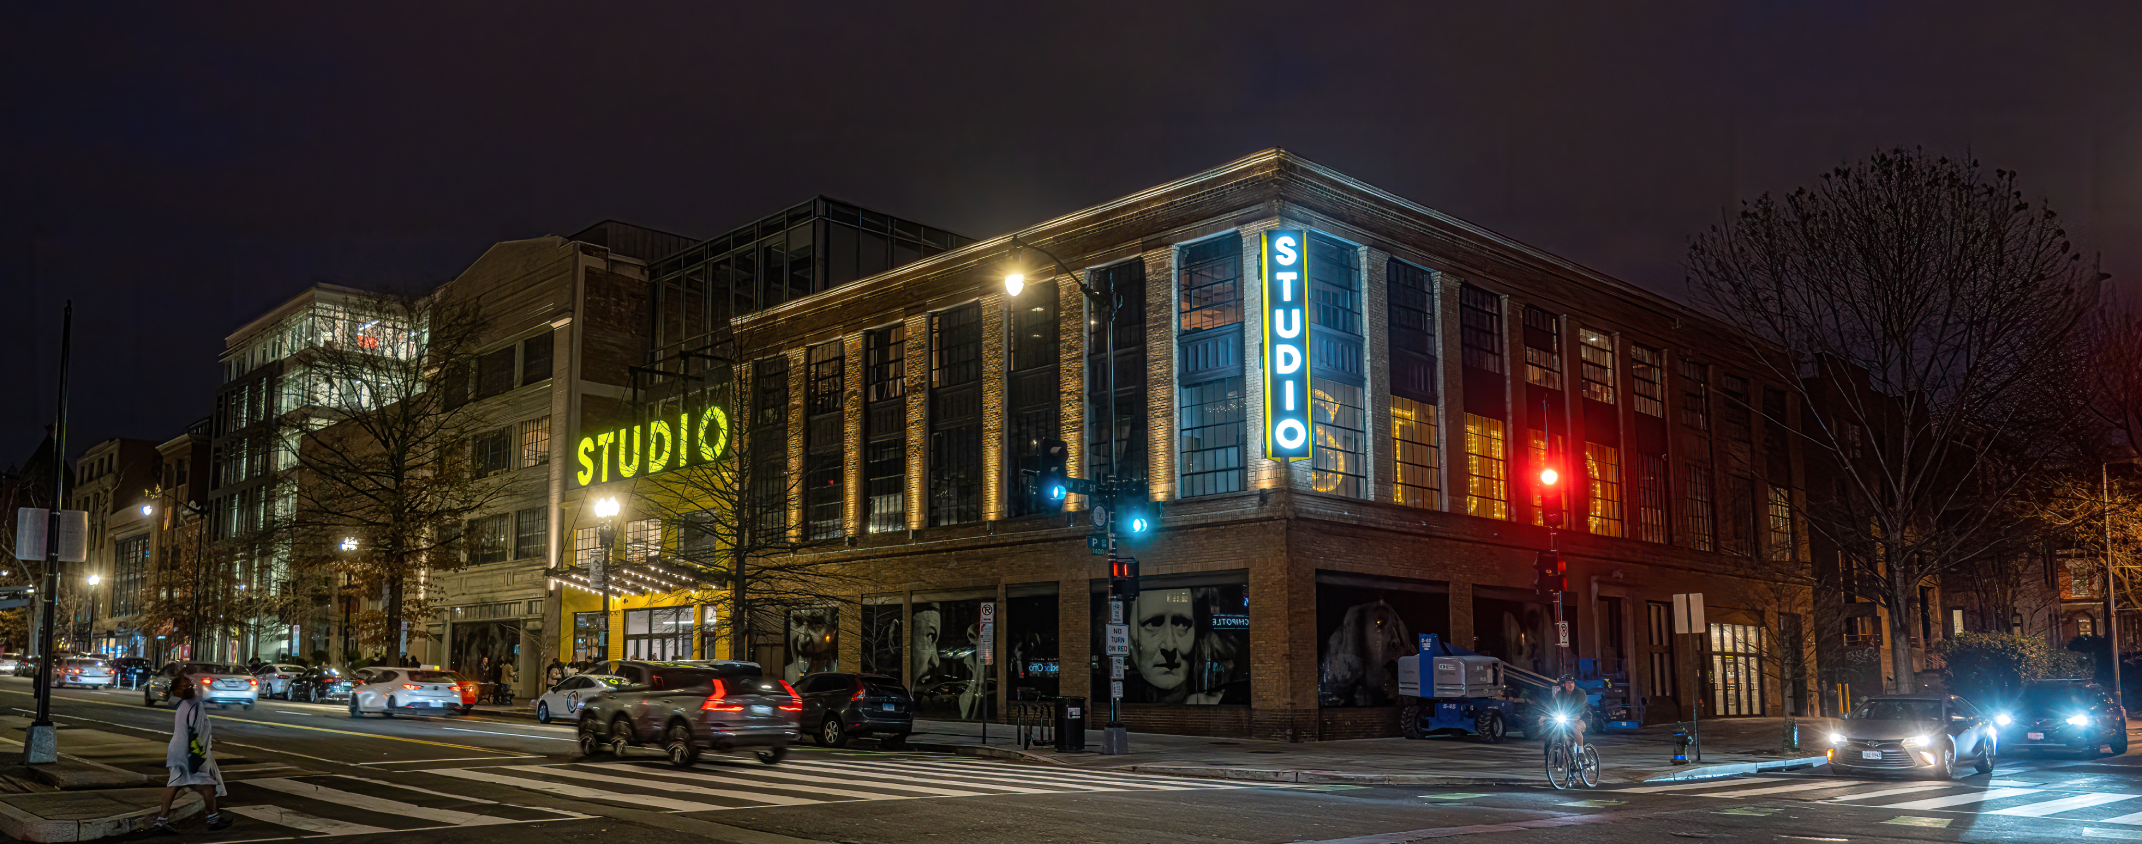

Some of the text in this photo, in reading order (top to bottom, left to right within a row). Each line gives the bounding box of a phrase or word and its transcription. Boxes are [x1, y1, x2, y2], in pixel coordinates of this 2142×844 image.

[1274, 234, 1307, 450] STUDIO
[576, 404, 730, 487] STUDIO
[1092, 537, 1098, 547] P
